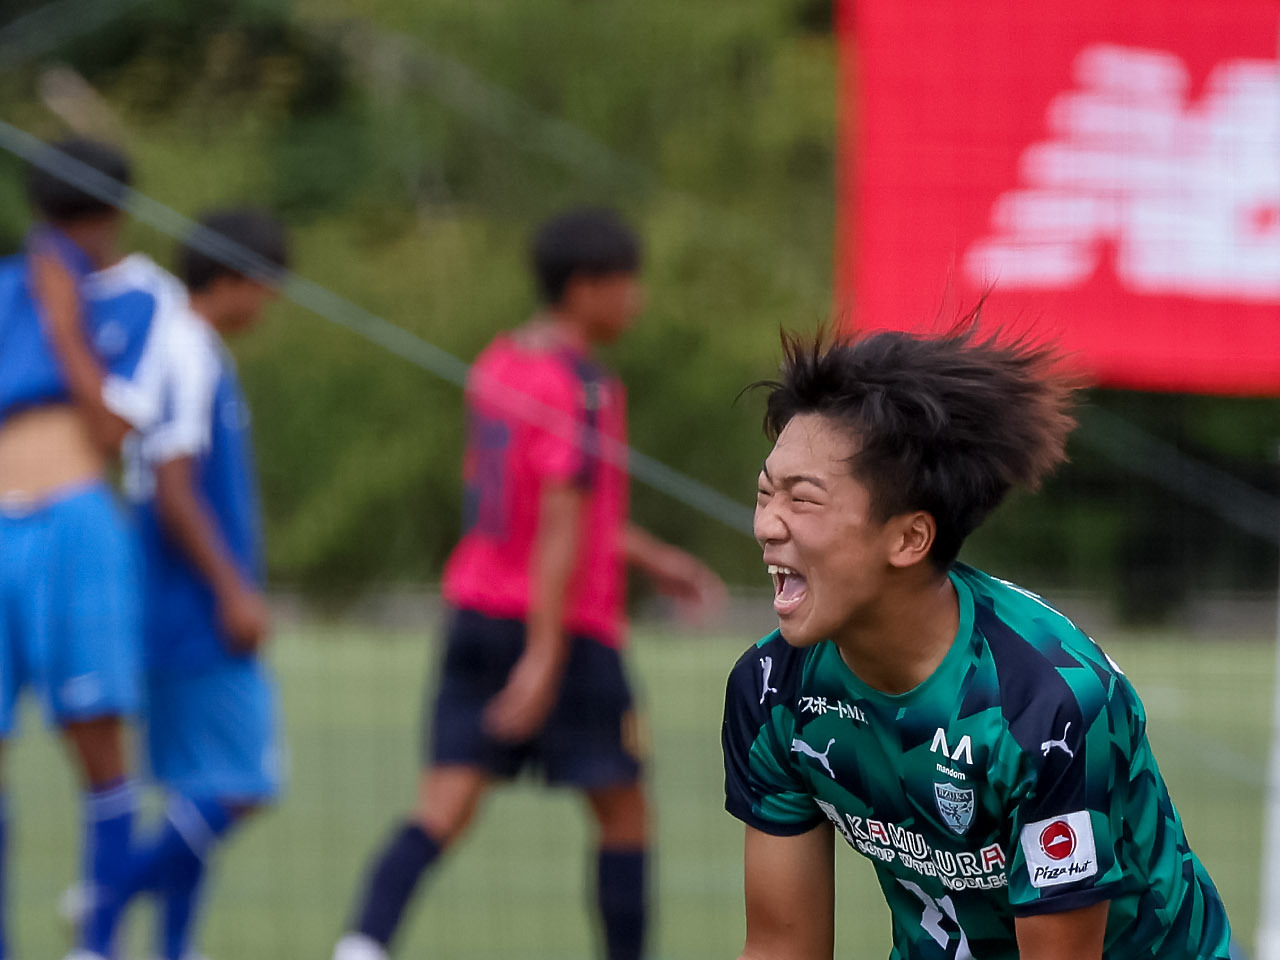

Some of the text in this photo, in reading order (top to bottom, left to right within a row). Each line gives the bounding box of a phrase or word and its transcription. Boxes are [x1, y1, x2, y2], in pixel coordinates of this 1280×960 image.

[936, 763, 966, 781] mandom
[845, 813, 1006, 877] KAMUURA
[1034, 860, 1093, 882] Pizza Hut
